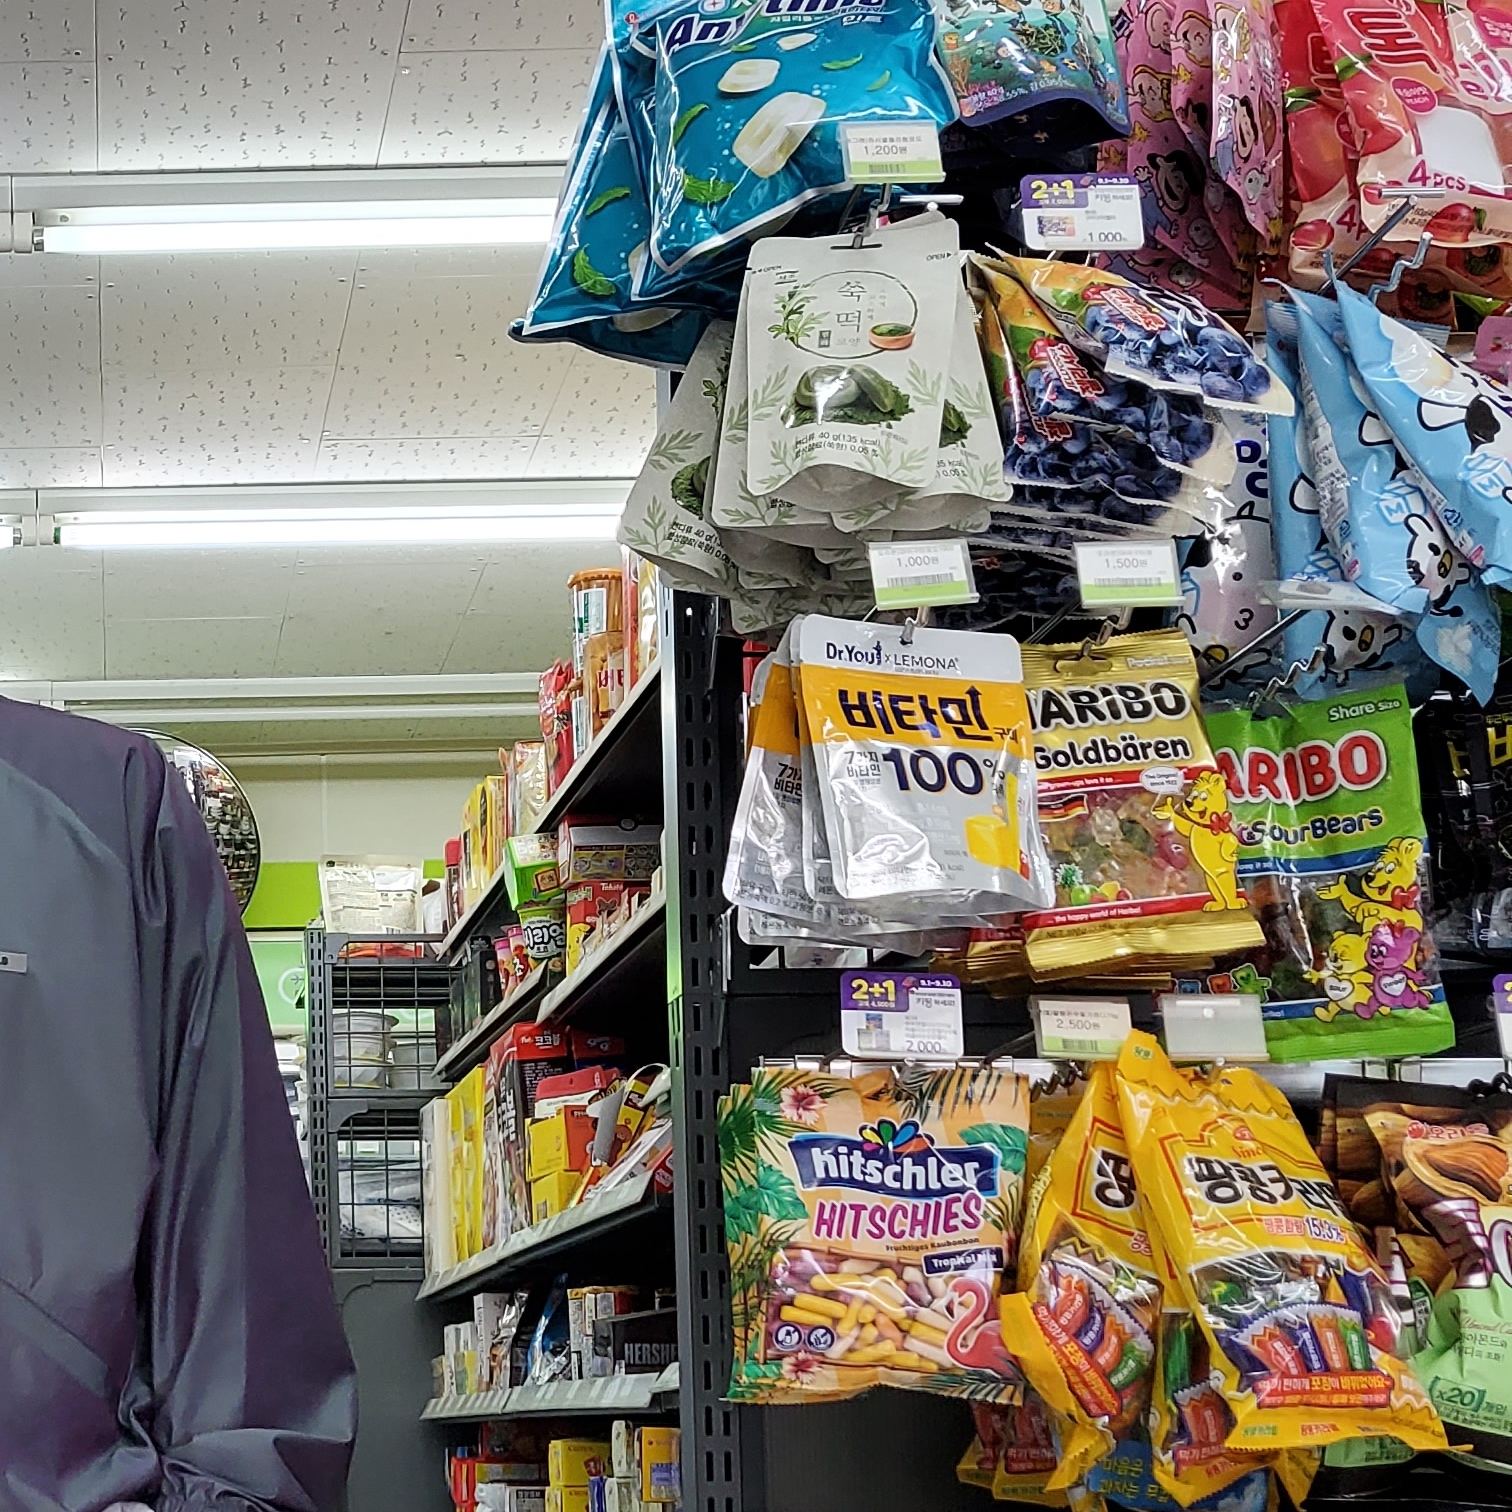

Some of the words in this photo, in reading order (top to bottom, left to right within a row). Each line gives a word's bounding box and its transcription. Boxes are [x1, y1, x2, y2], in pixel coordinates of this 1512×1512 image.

[1031, 180, 1074, 199] 2+1
[926, 252, 946, 261] OPEN
[818, 432, 829, 440] 40
[894, 654, 957, 670] LEMONA
[838, 686, 993, 742] 비타민
[1330, 702, 1375, 721] Share
[1034, 736, 1190, 768] Goldbären
[1216, 735, 1384, 798] ARIBO
[852, 979, 895, 1001] 2+1
[812, 1147, 978, 1190] hitschler
[815, 1193, 982, 1239] HITSCHIES
[885, 1243, 929, 1252] Fruchtiges
[931, 1237, 979, 1249] Kaubonbon
